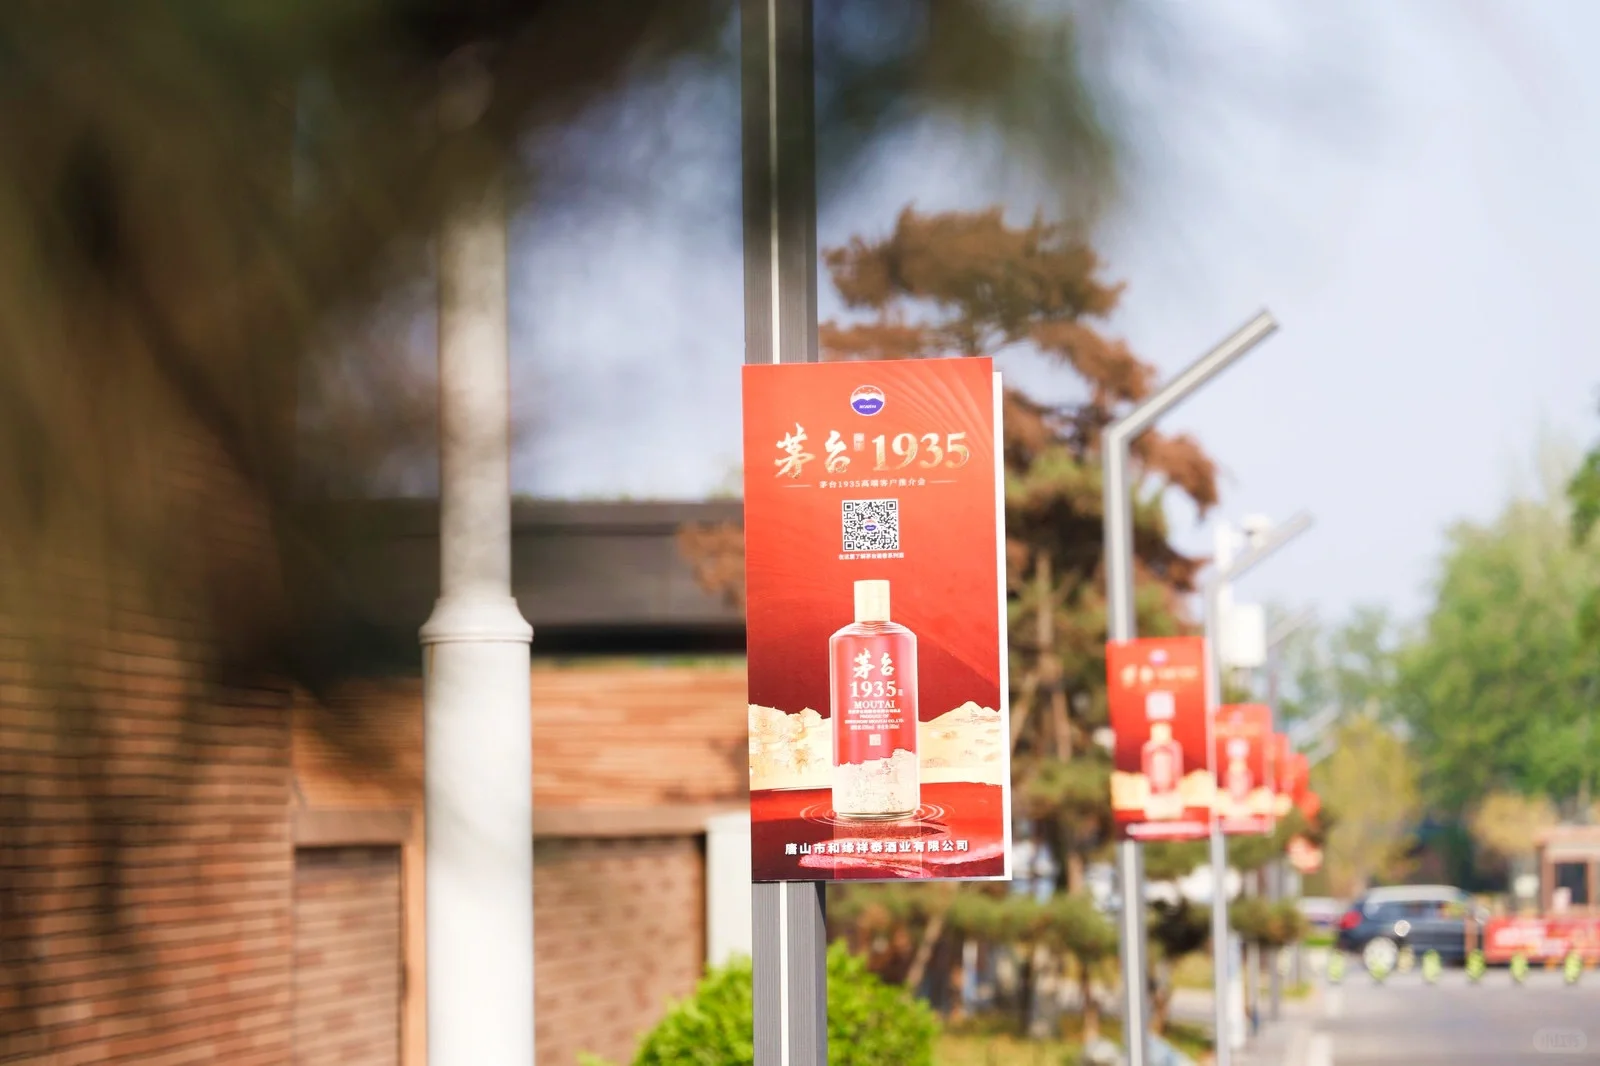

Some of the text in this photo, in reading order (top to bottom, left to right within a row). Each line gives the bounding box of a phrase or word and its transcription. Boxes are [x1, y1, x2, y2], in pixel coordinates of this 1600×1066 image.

[774, 422, 970, 479] 茅台 1935
[852, 648, 895, 680] 茅台
[849, 680, 897, 698] 1935
[854, 700, 895, 709] MOUTAI
